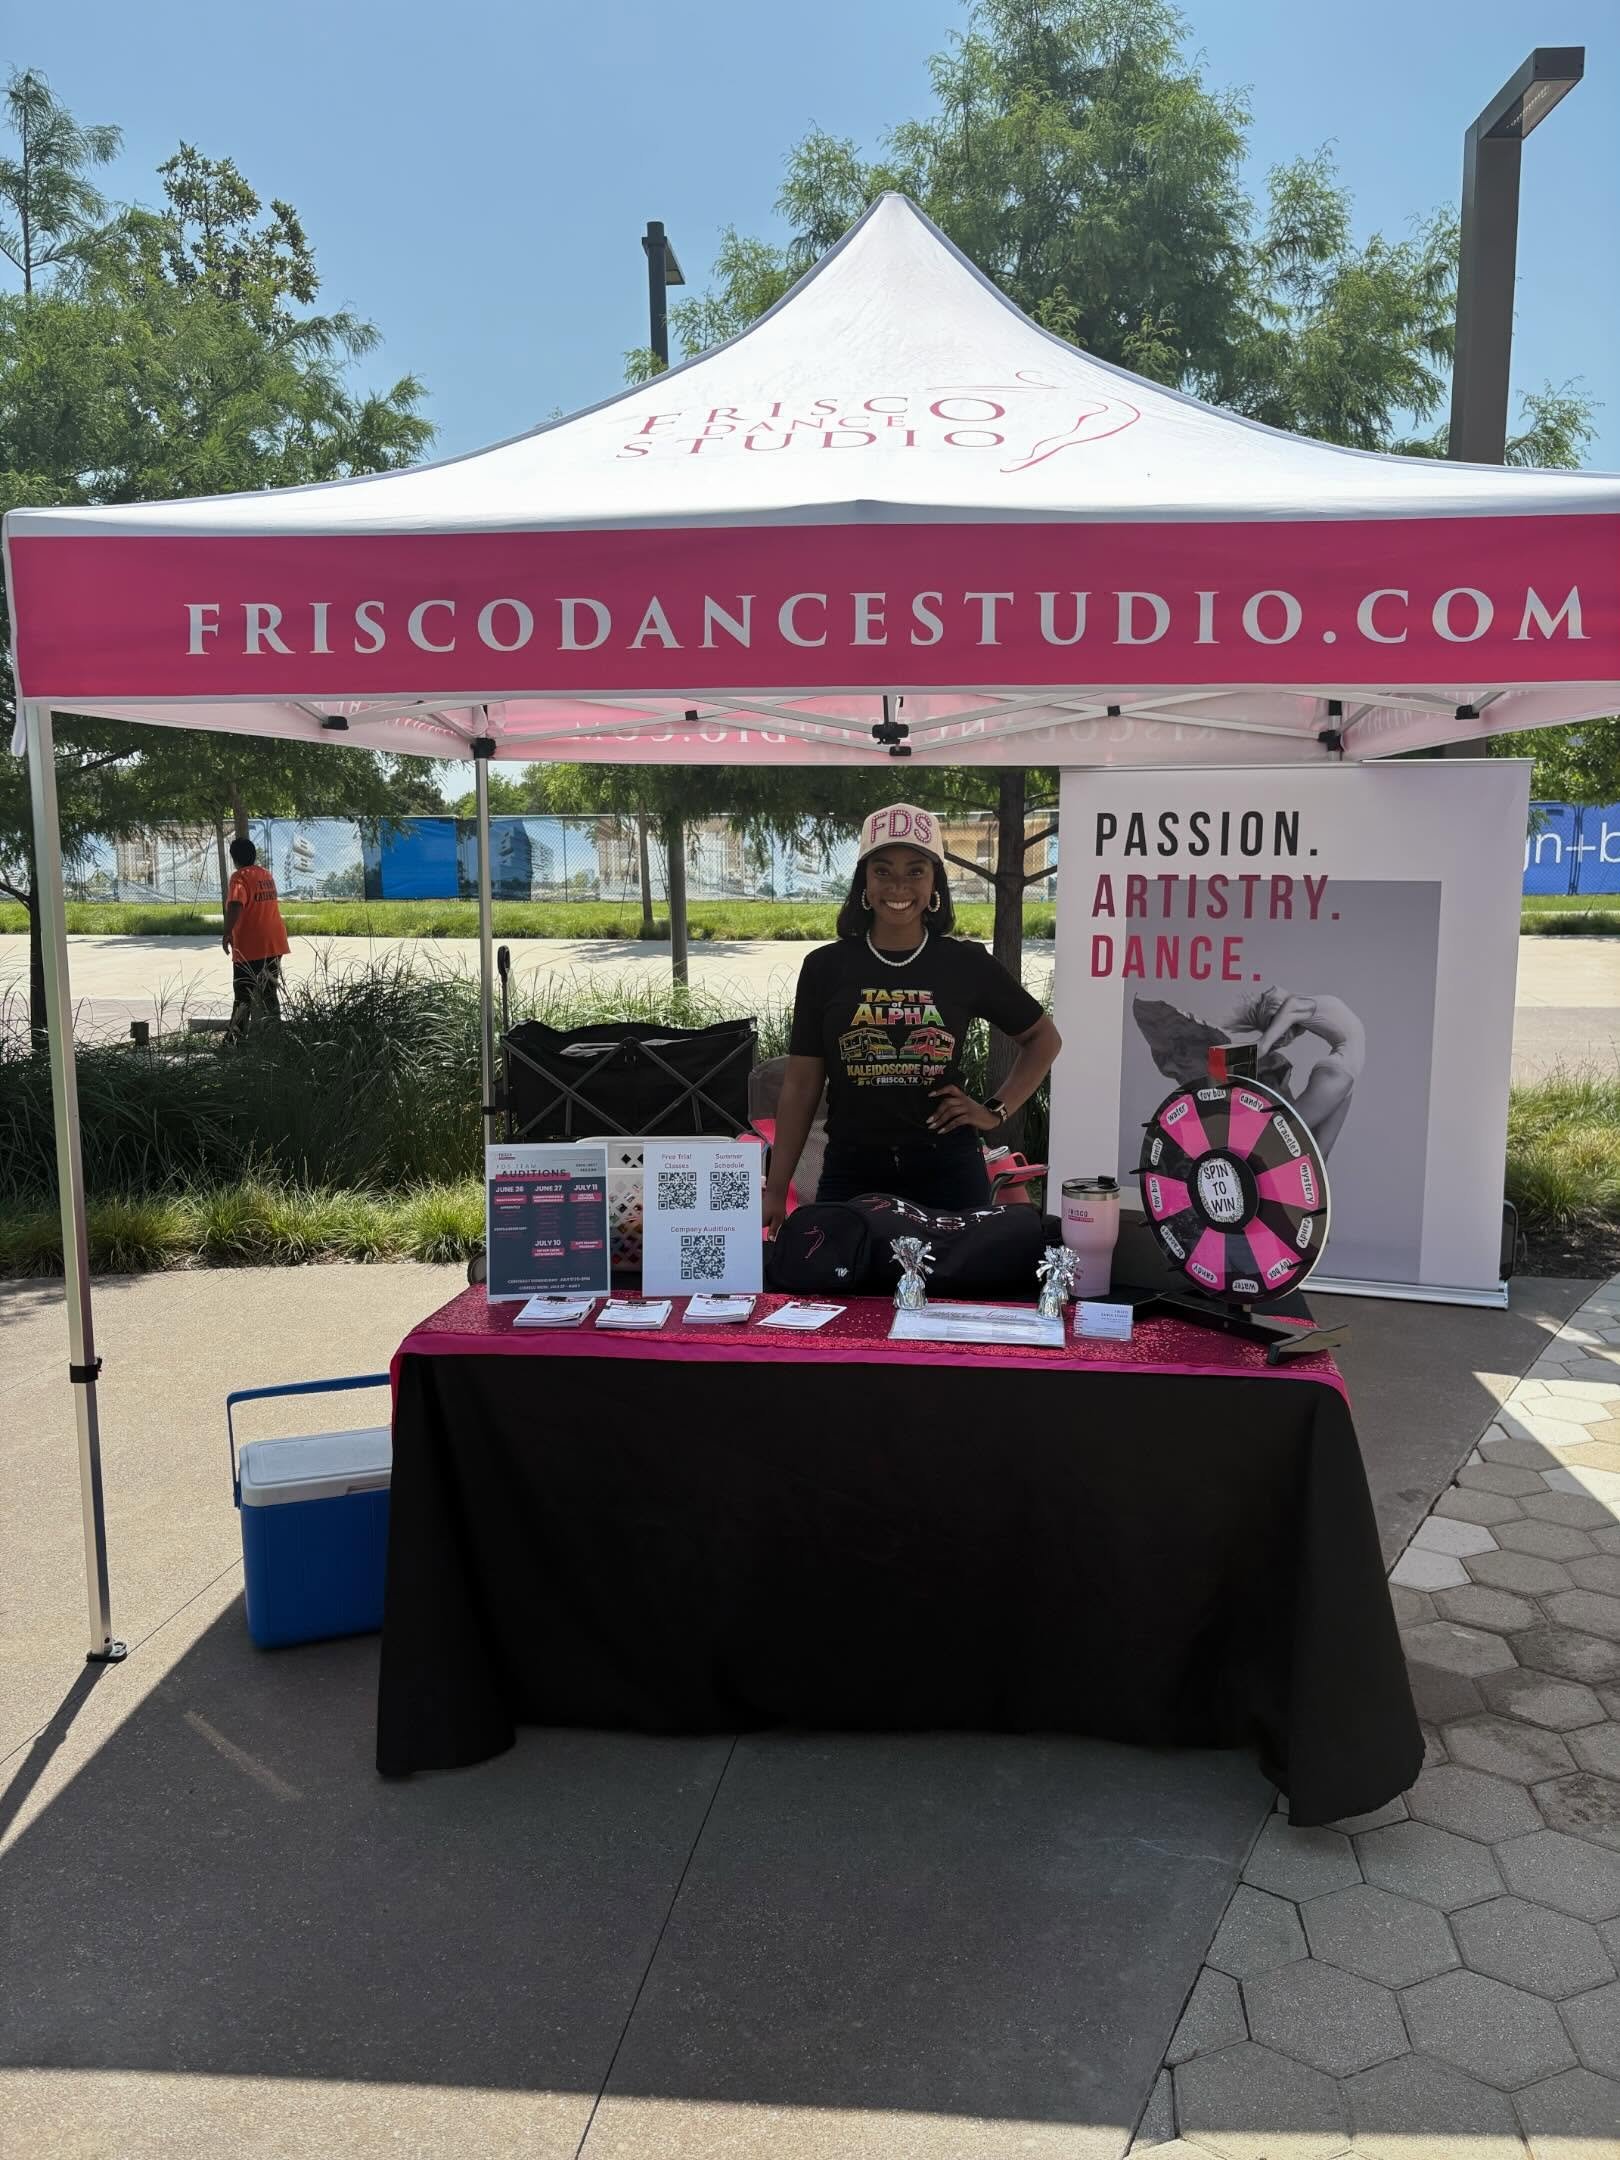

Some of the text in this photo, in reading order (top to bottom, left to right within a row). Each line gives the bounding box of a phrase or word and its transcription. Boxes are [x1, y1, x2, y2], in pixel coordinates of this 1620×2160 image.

[634, 396, 1006, 435] FRISCO
[700, 415, 906, 436] DANCE
[615, 429, 1006, 459] STUDIO
[185, 584, 1591, 656] FRISCODANCESTUDIO.COM
[870, 808, 932, 843] FDS
[1095, 810, 1318, 857] PASSION.
[1091, 873, 1341, 920] ARTISTRY.
[1090, 934, 1262, 981] DANCE.
[861, 988, 934, 1004] TASTE
[850, 1003, 945, 1026] ALPHA
[847, 1063, 946, 1076] KALEIDOSCOPE PARK
[876, 1076, 919, 1084] FRISCO, TX
[1167, 1104, 1188, 1122] water
[1276, 1118, 1299, 1155] bracelet
[502, 1168, 567, 1178] AUDITIONS
[1203, 1163, 1229, 1180] SPIN
[554, 1184, 562, 1192] 27
[1212, 1181, 1227, 1196] TO
[1301, 1164, 1316, 1203] mystery
[1211, 1197, 1236, 1214] WIN
[670, 1226, 702, 1234] Company
[534, 1239, 553, 1247] JULY
